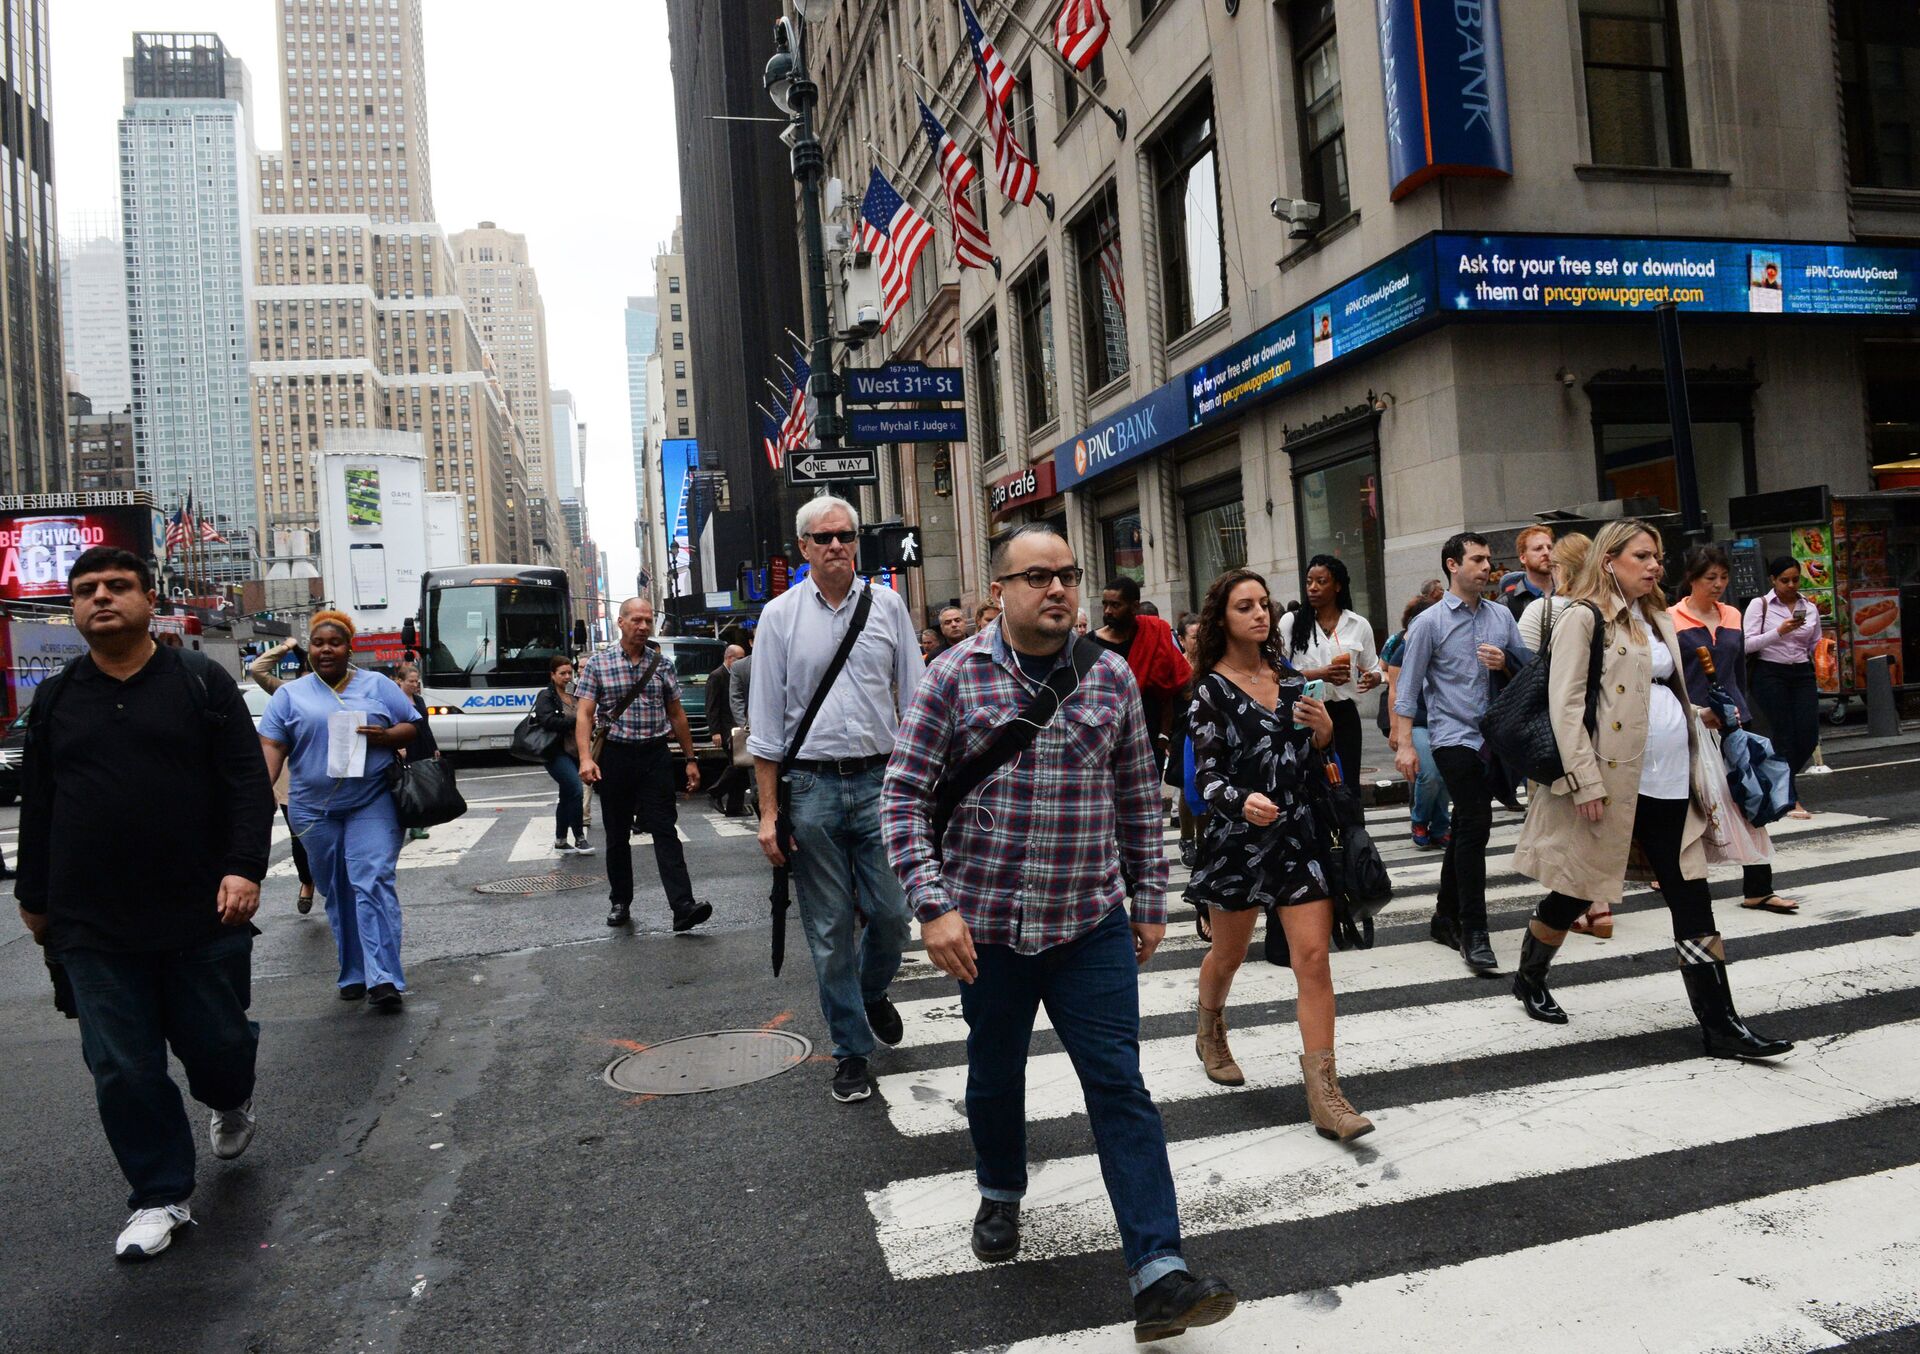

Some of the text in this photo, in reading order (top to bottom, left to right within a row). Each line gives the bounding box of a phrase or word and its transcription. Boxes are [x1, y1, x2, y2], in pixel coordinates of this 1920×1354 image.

[1455, 0, 1492, 134] BANK
[1458, 254, 1715, 279] Ask for your free set or download
[1805, 265, 1898, 282] #PNCGrowUpGreat
[1345, 273, 1410, 317] #PNCGrowUpGreat
[1475, 281, 1704, 306] them at pncgrowupgreat.com
[1193, 329, 1296, 398] Ask for your free set or download
[857, 376, 953, 393] West 31st St
[1199, 360, 1291, 415] them at pncgrowupgreat.com
[857, 424, 878, 432] Father
[880, 421, 912, 433] Mychal
[914, 420, 920, 430] F.
[922, 420, 948, 433] Judge
[1087, 404, 1157, 467] PNC BANK
[804, 459, 862, 472] ONE WAY
[1008, 469, 1036, 498] café
[31, 493, 78, 509] SQUARE
[86, 490, 134, 506] GARDEN
[0, 527, 104, 547] BEECHWOOD
[0, 544, 100, 586] AGE
[462, 694, 536, 708] ACADEMY
